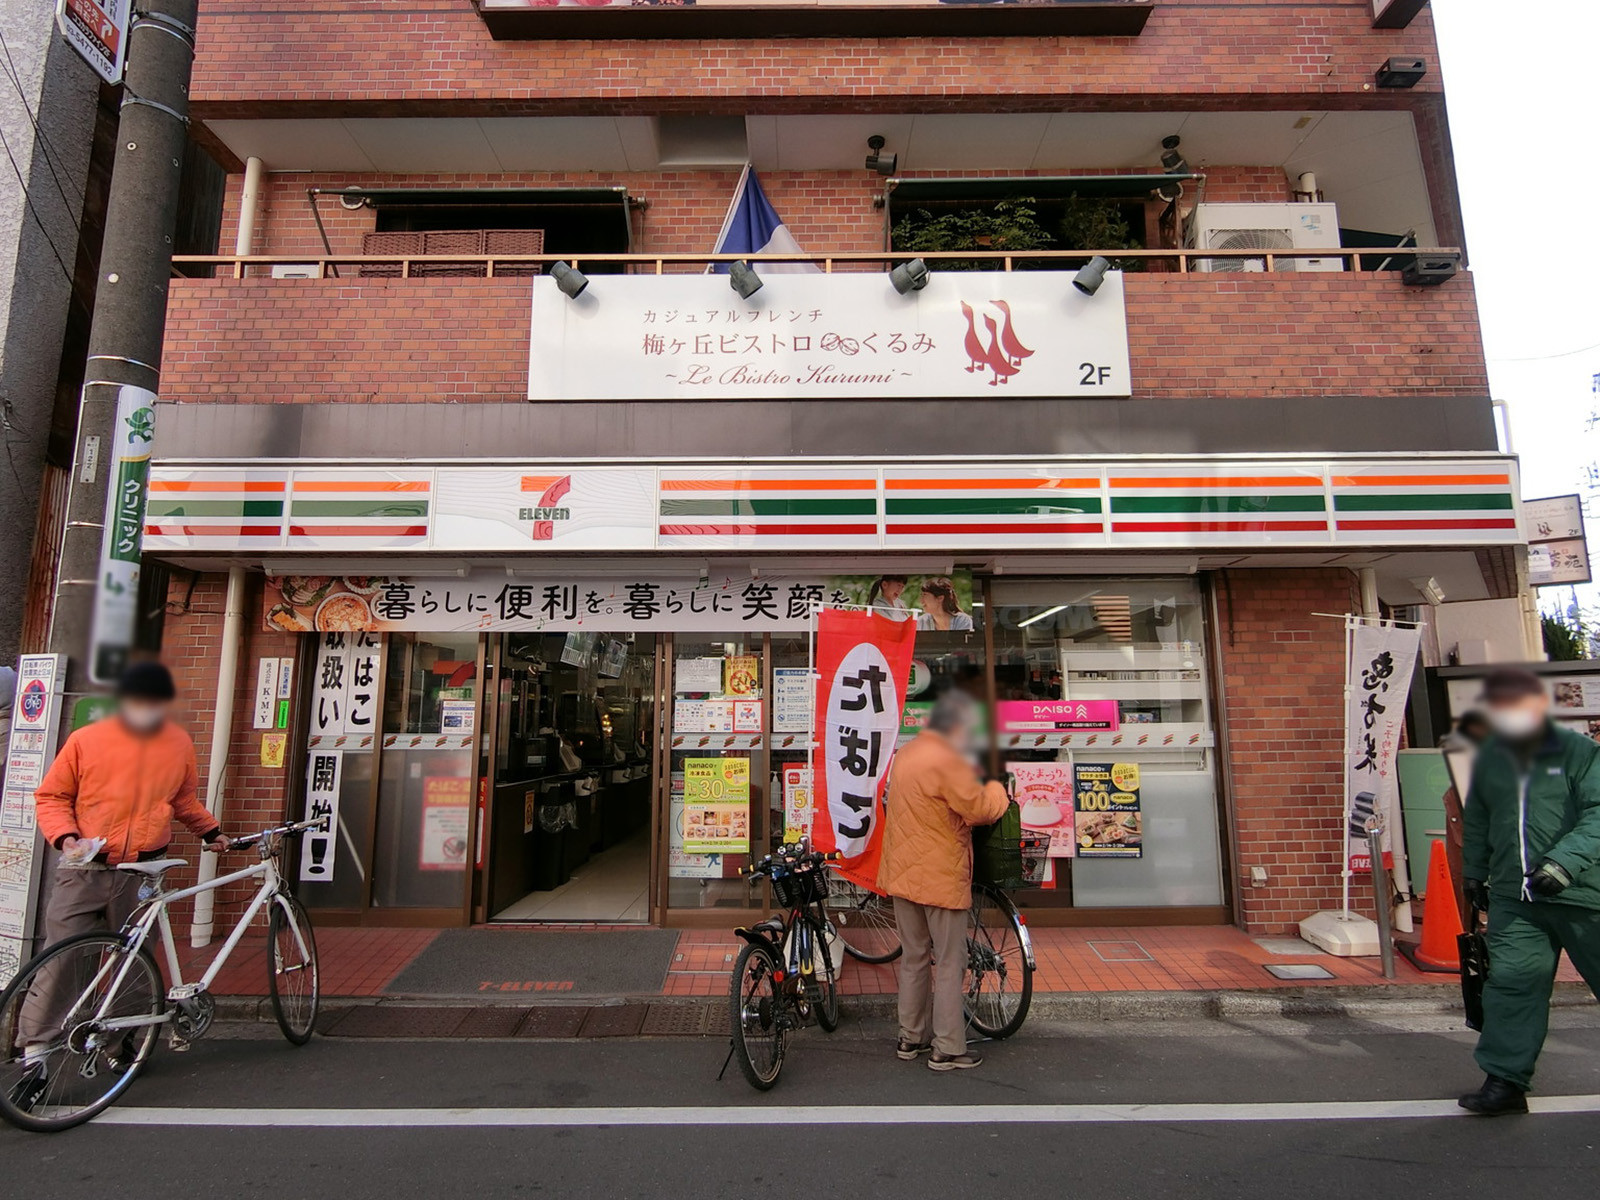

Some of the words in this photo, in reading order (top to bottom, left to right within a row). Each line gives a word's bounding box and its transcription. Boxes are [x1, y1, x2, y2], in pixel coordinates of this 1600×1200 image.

[643, 309, 823, 323] カジュアルフレンチ
[641, 333, 811, 356] 梅ヶ丘ビストロ
[862, 332, 936, 354] くるみ
[718, 362, 791, 385] Bistro
[1079, 362, 1111, 385] 2F
[119, 480, 141, 553] クリニック
[1033, 705, 1073, 714] DAISO
[699, 779, 725, 800] 30
[1078, 791, 1110, 811] 100
